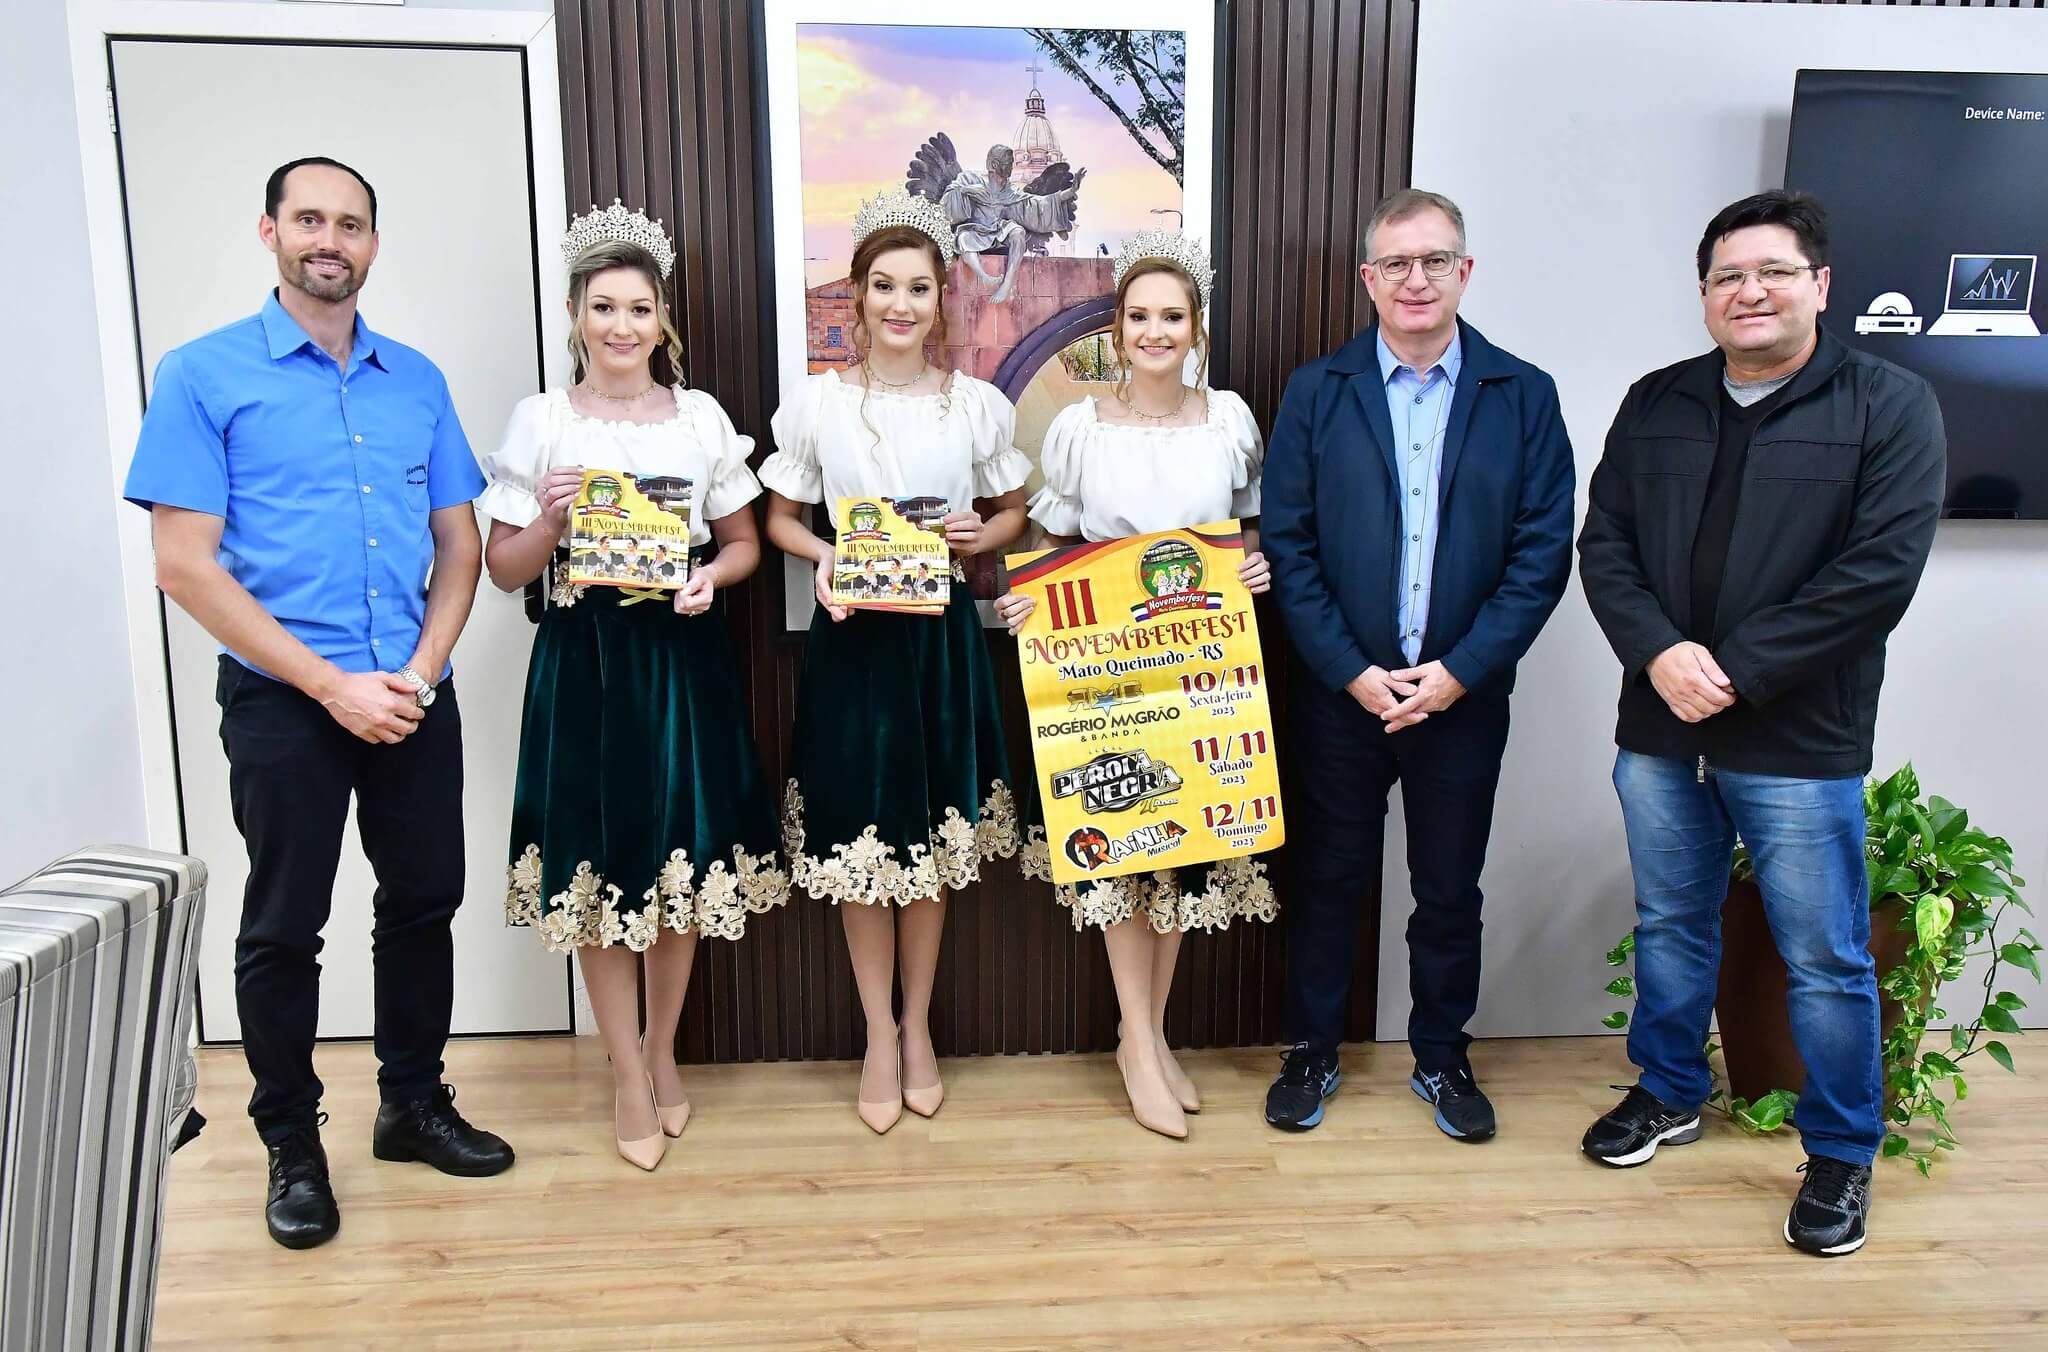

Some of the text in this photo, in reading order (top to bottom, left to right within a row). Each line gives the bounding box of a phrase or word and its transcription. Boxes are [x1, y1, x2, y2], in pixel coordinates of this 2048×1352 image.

[1965, 106, 2045, 120] Device Name:
[581, 517, 592, 528] III
[847, 543, 856, 553] III
[1045, 578, 1098, 631] III
[1149, 593, 1205, 610] Novemberfest
[1026, 611, 1248, 665] NOVEMBERFEST
[1058, 663, 1102, 681] Mato
[1106, 650, 1185, 678] Queimado
[1198, 643, 1224, 661] RS
[1190, 690, 1252, 708] Sexta-feira
[1212, 706, 1235, 716] 2023
[1037, 705, 1180, 739] ROGÉRIO MAGRÃO
[1092, 728, 1140, 741] BANDA
[1208, 758, 1253, 776] Sábado
[1084, 766, 1183, 809] NEGRA
[1220, 775, 1246, 785] 2023
[1214, 822, 1268, 840] Domingo
[1147, 837, 1181, 858] Musical
[1230, 837, 1255, 848] 2023
